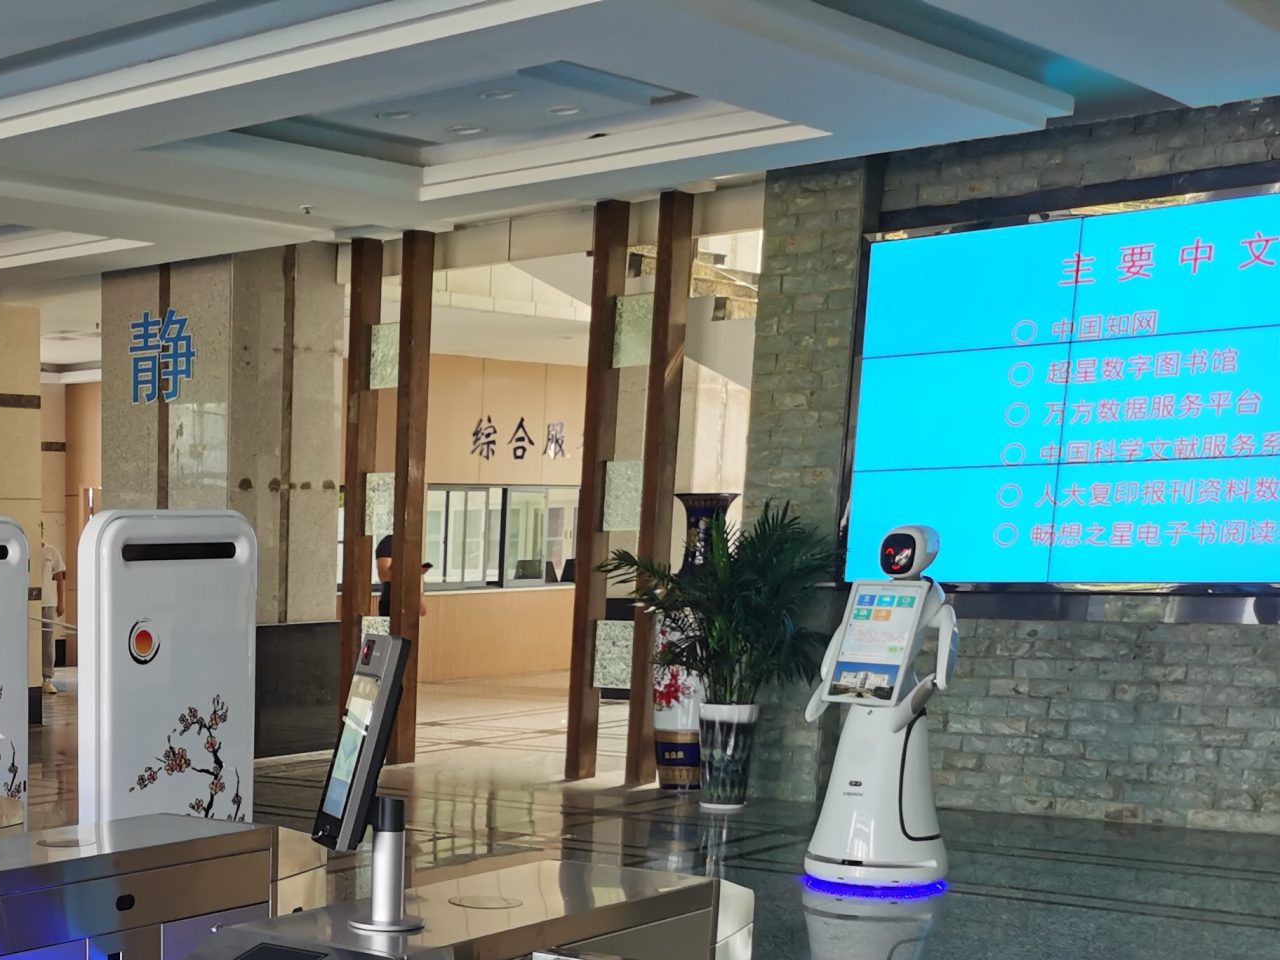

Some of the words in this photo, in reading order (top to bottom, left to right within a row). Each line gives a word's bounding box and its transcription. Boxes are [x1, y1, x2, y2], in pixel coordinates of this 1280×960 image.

[1058, 231, 1280, 286] 主要中文
[1051, 309, 1158, 343] 中国知网
[128, 307, 197, 405] 静
[1046, 347, 1238, 385] 超星数字图书馆
[1042, 389, 1262, 425] 万方数据服务平台
[470, 414, 584, 460] 综合服
[1034, 477, 1280, 507] 人大复印报刊资料数
[1030, 519, 1280, 547] 畅想之星电子书阅读
